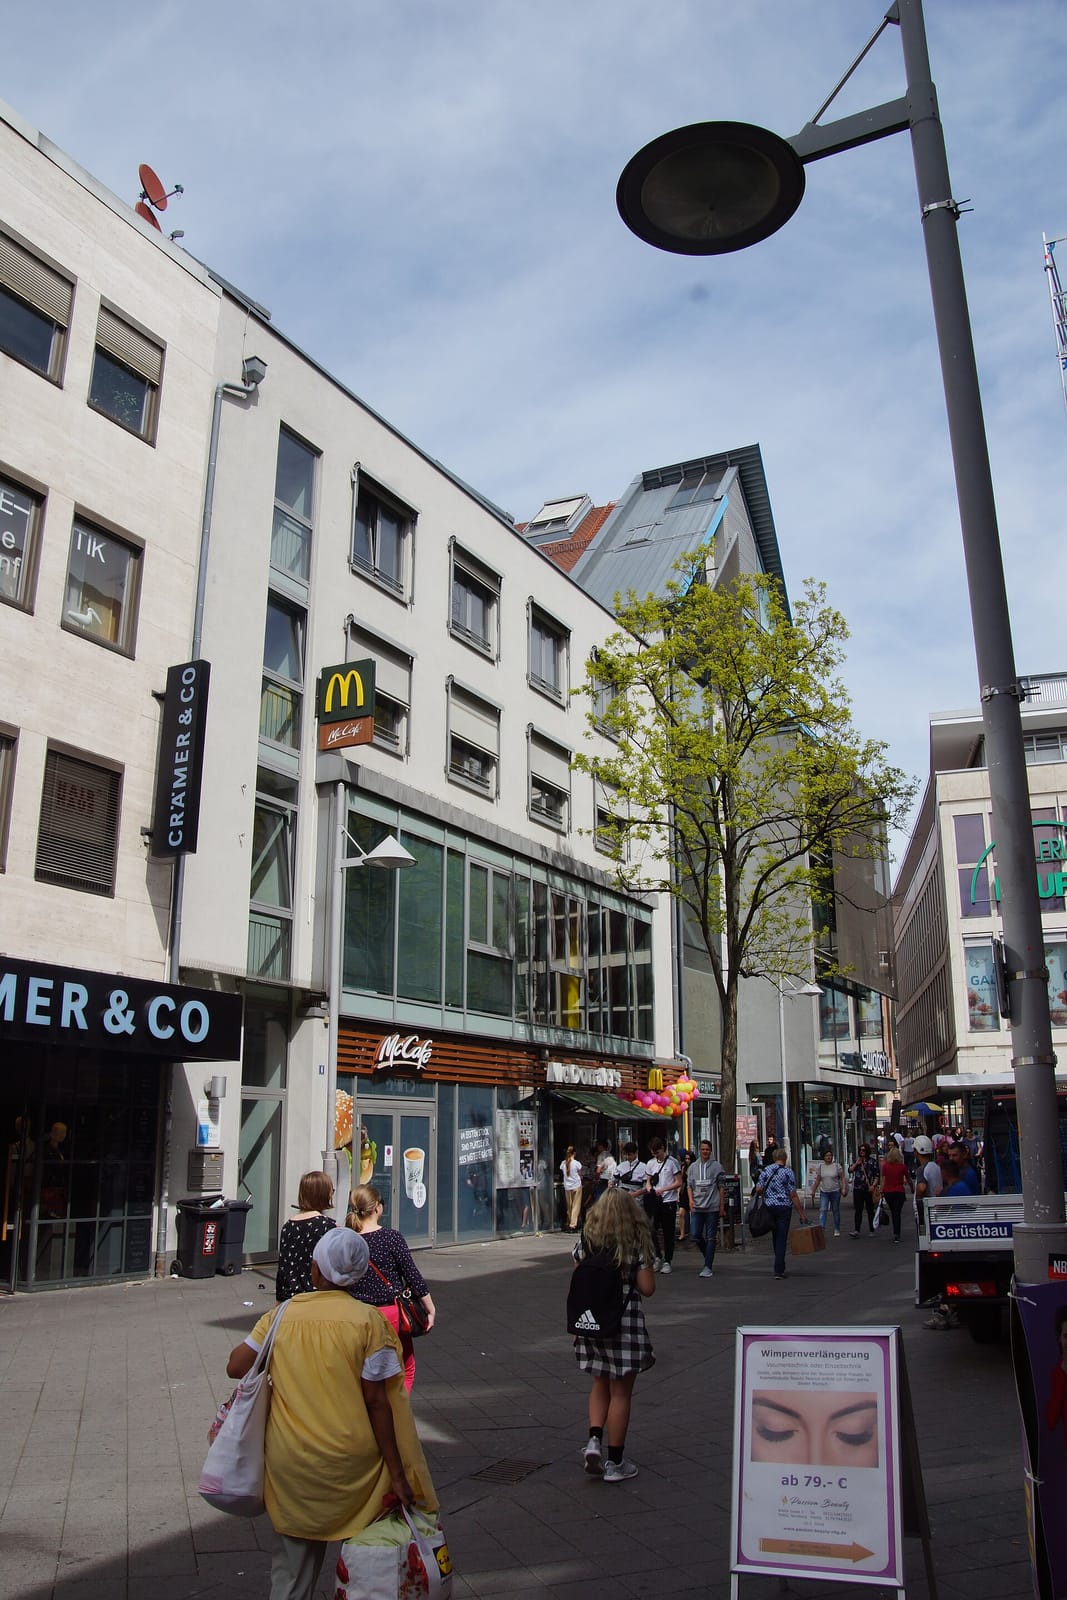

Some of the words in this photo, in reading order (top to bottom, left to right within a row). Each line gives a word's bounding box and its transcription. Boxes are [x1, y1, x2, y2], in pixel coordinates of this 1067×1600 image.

[74, 528, 107, 563] TIK
[180, 667, 196, 703] CO
[178, 707, 193, 726] &
[168, 731, 191, 847] CRÄMER
[103, 989, 136, 1036] &
[147, 995, 210, 1043] CO
[935, 1224, 1008, 1238] Gerüstbau
[761, 1349, 870, 1360] Wimpernverlängerung
[781, 1475, 798, 1486] ab
[804, 1475, 833, 1488] 79.-
